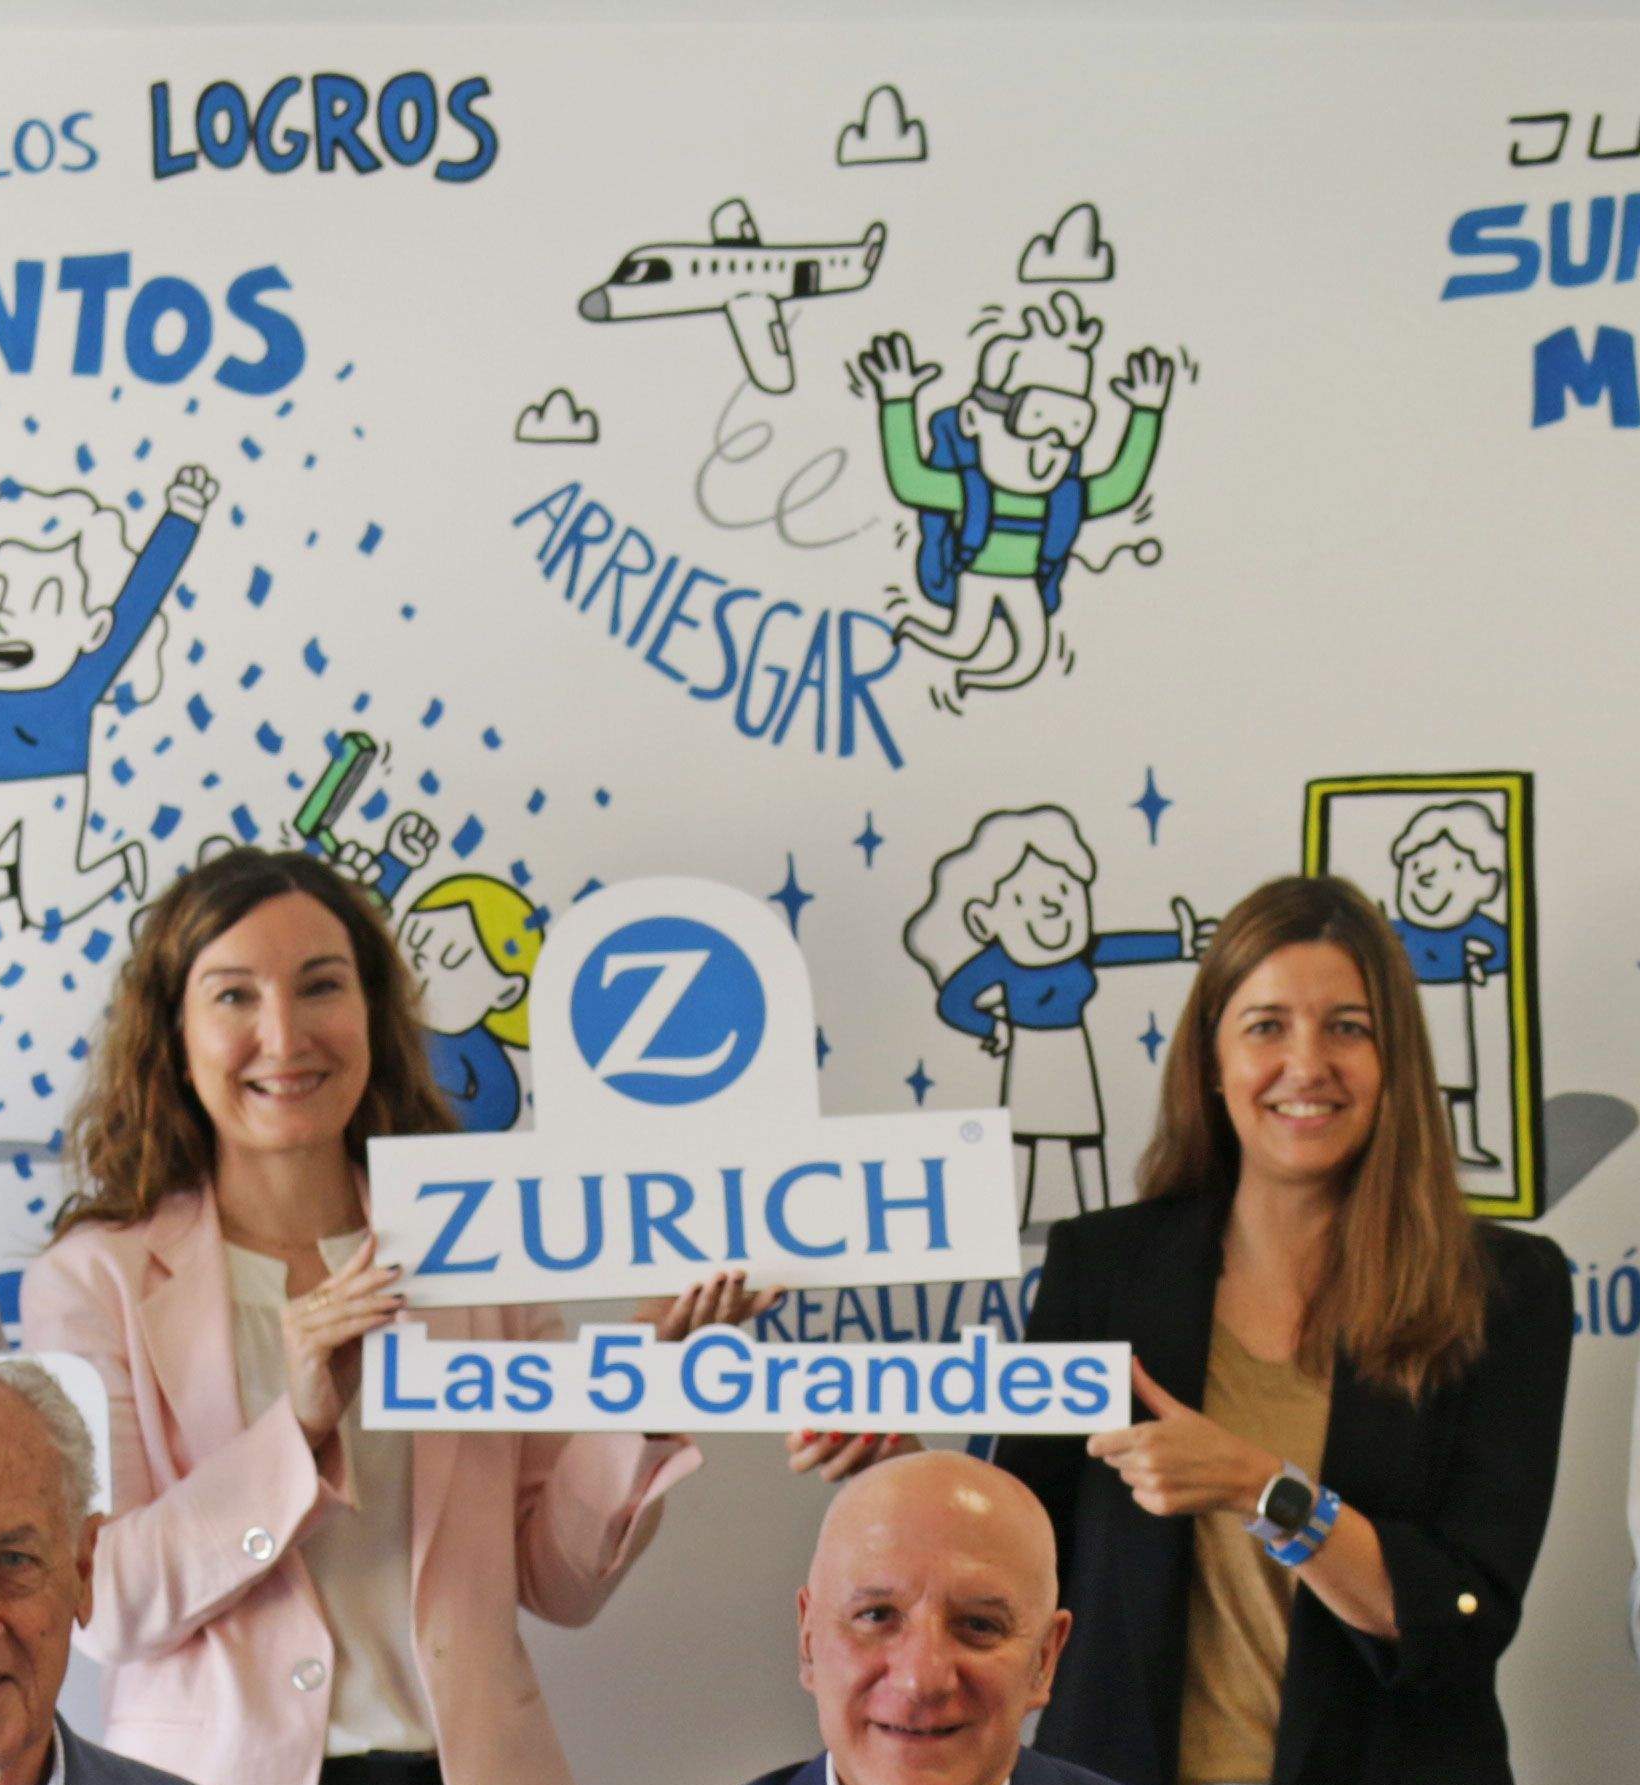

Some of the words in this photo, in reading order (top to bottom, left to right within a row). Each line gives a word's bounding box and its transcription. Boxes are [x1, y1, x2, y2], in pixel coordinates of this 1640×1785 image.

[150, 71, 499, 183] LOGROS
[512, 481, 904, 771] ARRIESGAR
[414, 1157, 953, 1276] ZURICH
[382, 1332, 554, 1414] Las
[587, 1334, 646, 1415] 5
[680, 1332, 1110, 1416] Grandes
